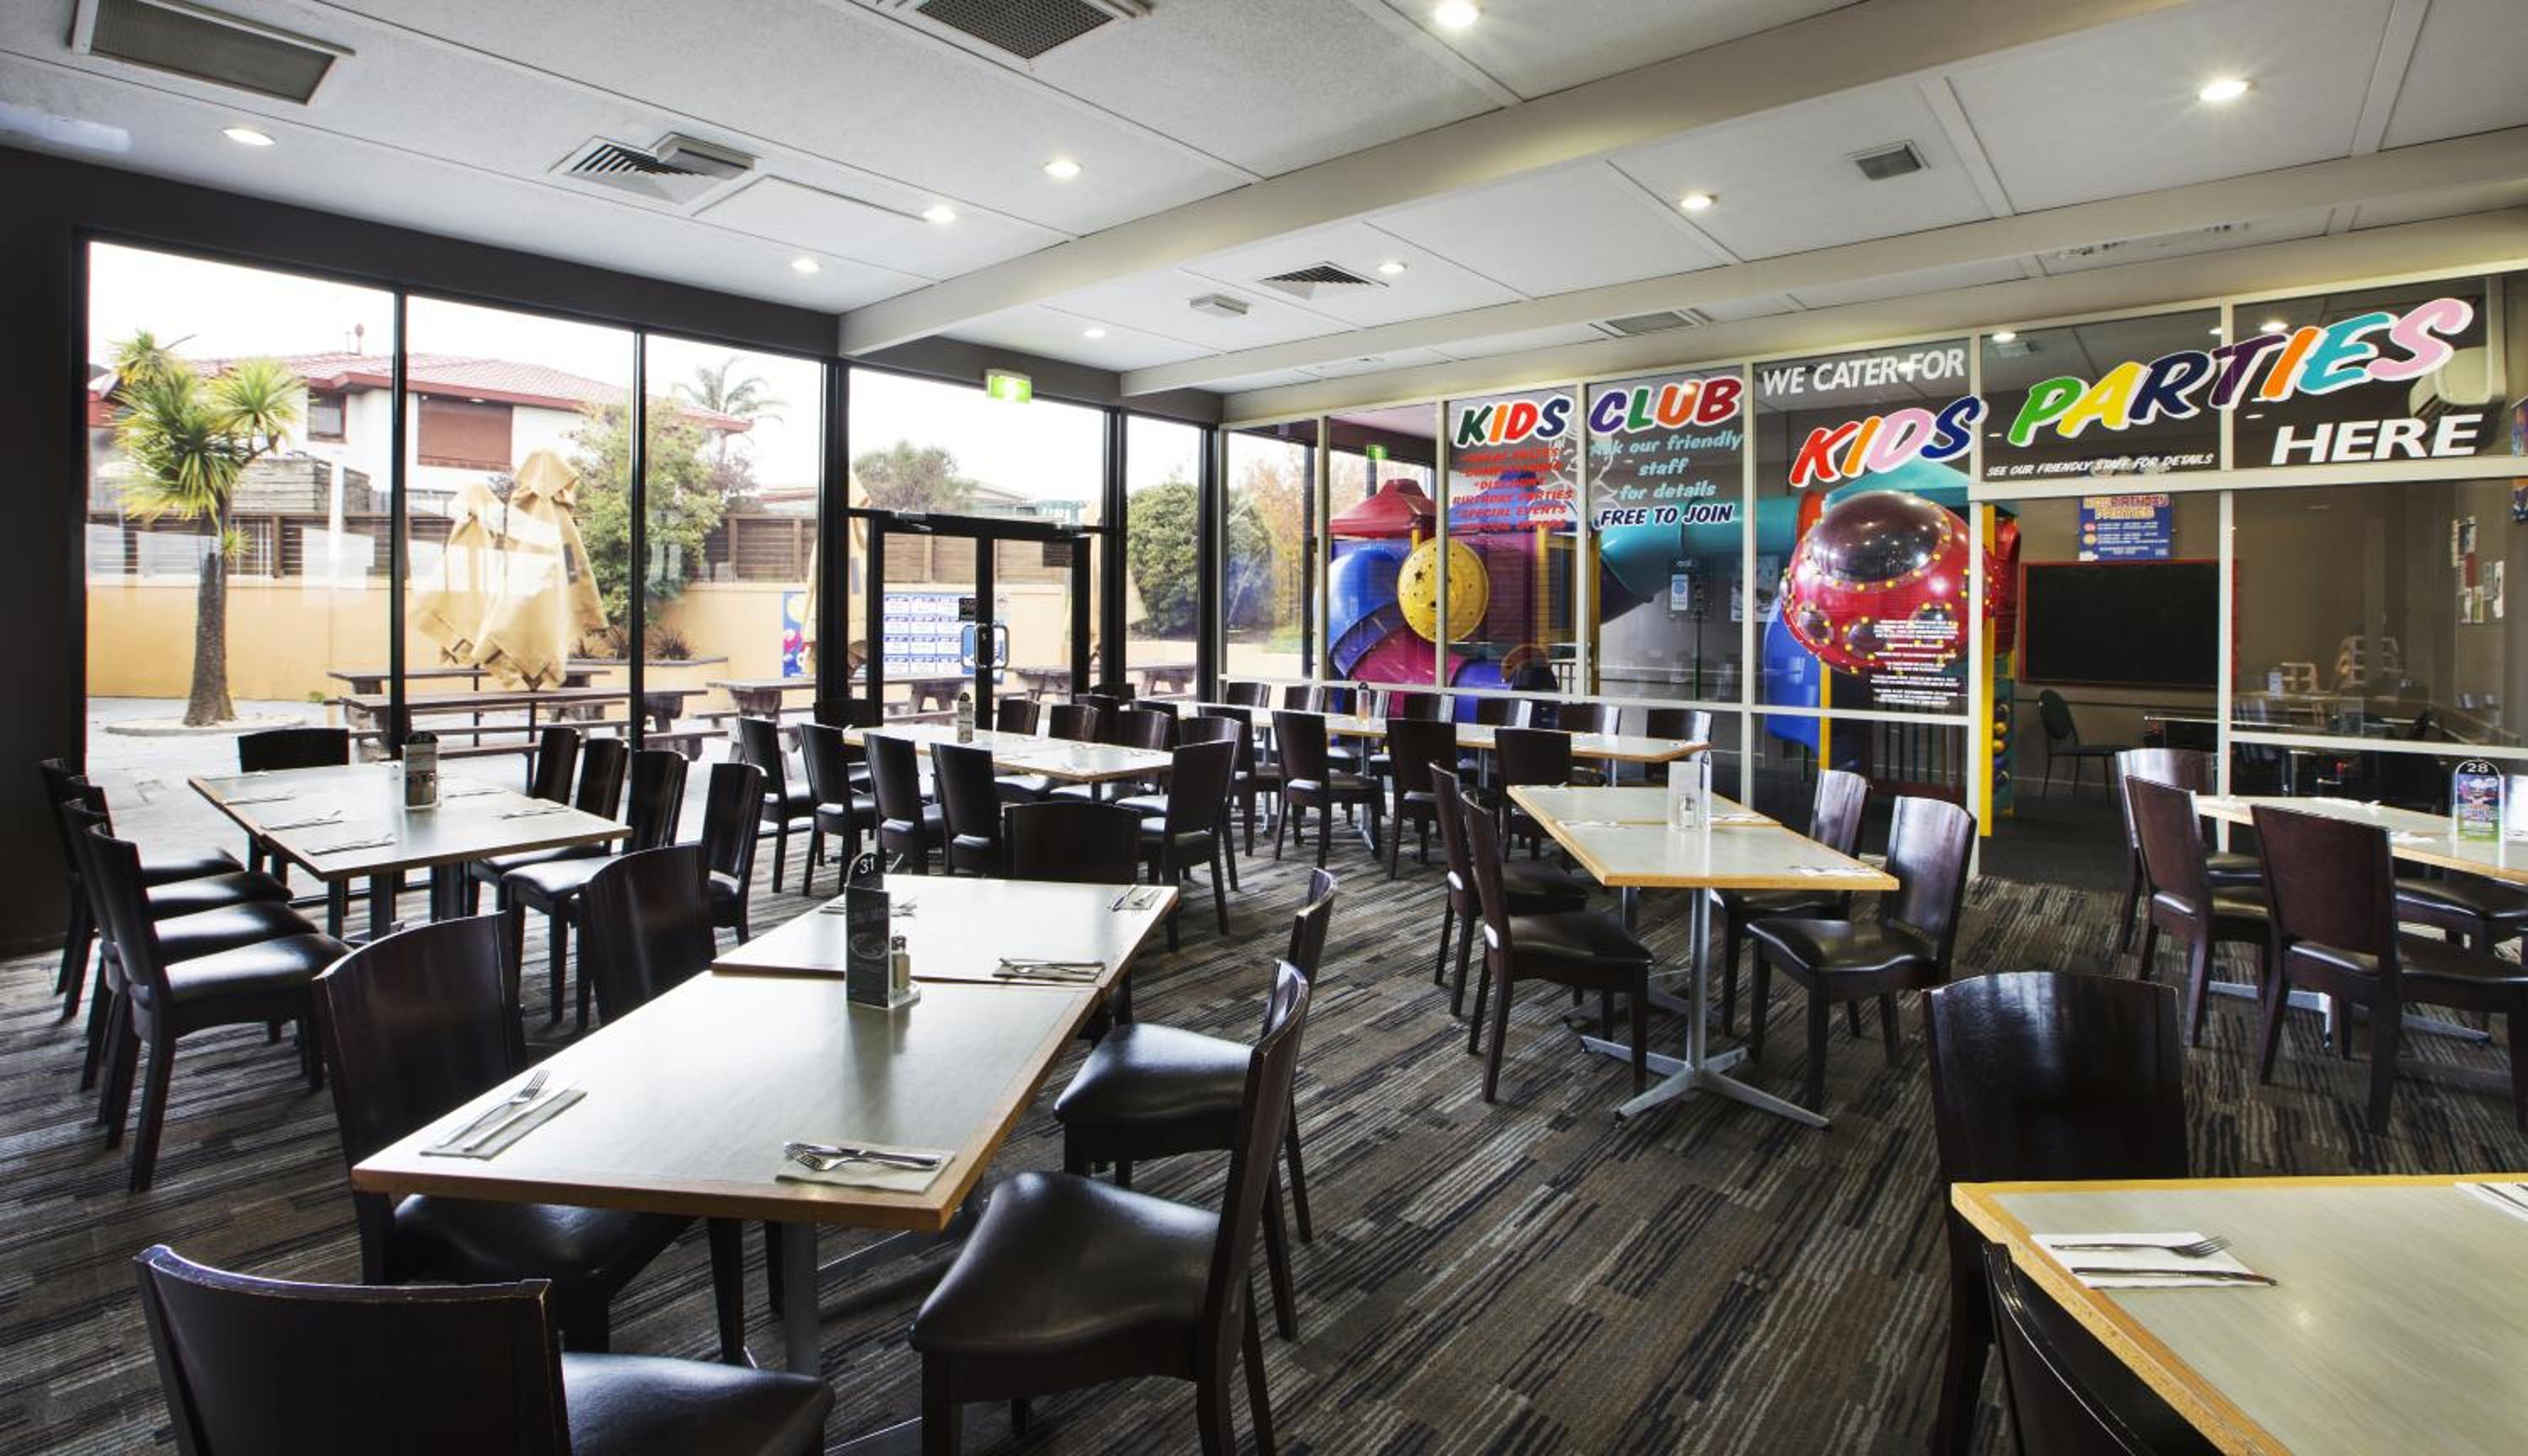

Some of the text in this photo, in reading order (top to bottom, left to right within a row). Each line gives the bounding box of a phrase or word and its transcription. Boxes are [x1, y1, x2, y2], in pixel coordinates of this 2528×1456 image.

[1763, 348, 1966, 396] WE CATER FOR
[2008, 297, 2474, 447] PARTIES
[1454, 377, 1743, 447] KIDS CLUB
[1630, 441, 1660, 453] our
[1667, 430, 1743, 451] friendly
[1788, 394, 1989, 487] KIDS
[2271, 413, 2483, 465] HERE
[1638, 458, 1690, 475] staff
[1987, 465, 2008, 477] SEE
[2010, 464, 2035, 475] OUR
[2037, 461, 2094, 474] FRIENDLY
[2133, 456, 2159, 468] FOR
[2163, 452, 2214, 466] DETAILS
[1619, 479, 1717, 500] for details
[1598, 504, 1734, 527] FREE TO JOIN
[2466, 763, 2489, 773] 28
[859, 856, 876, 875] 31
